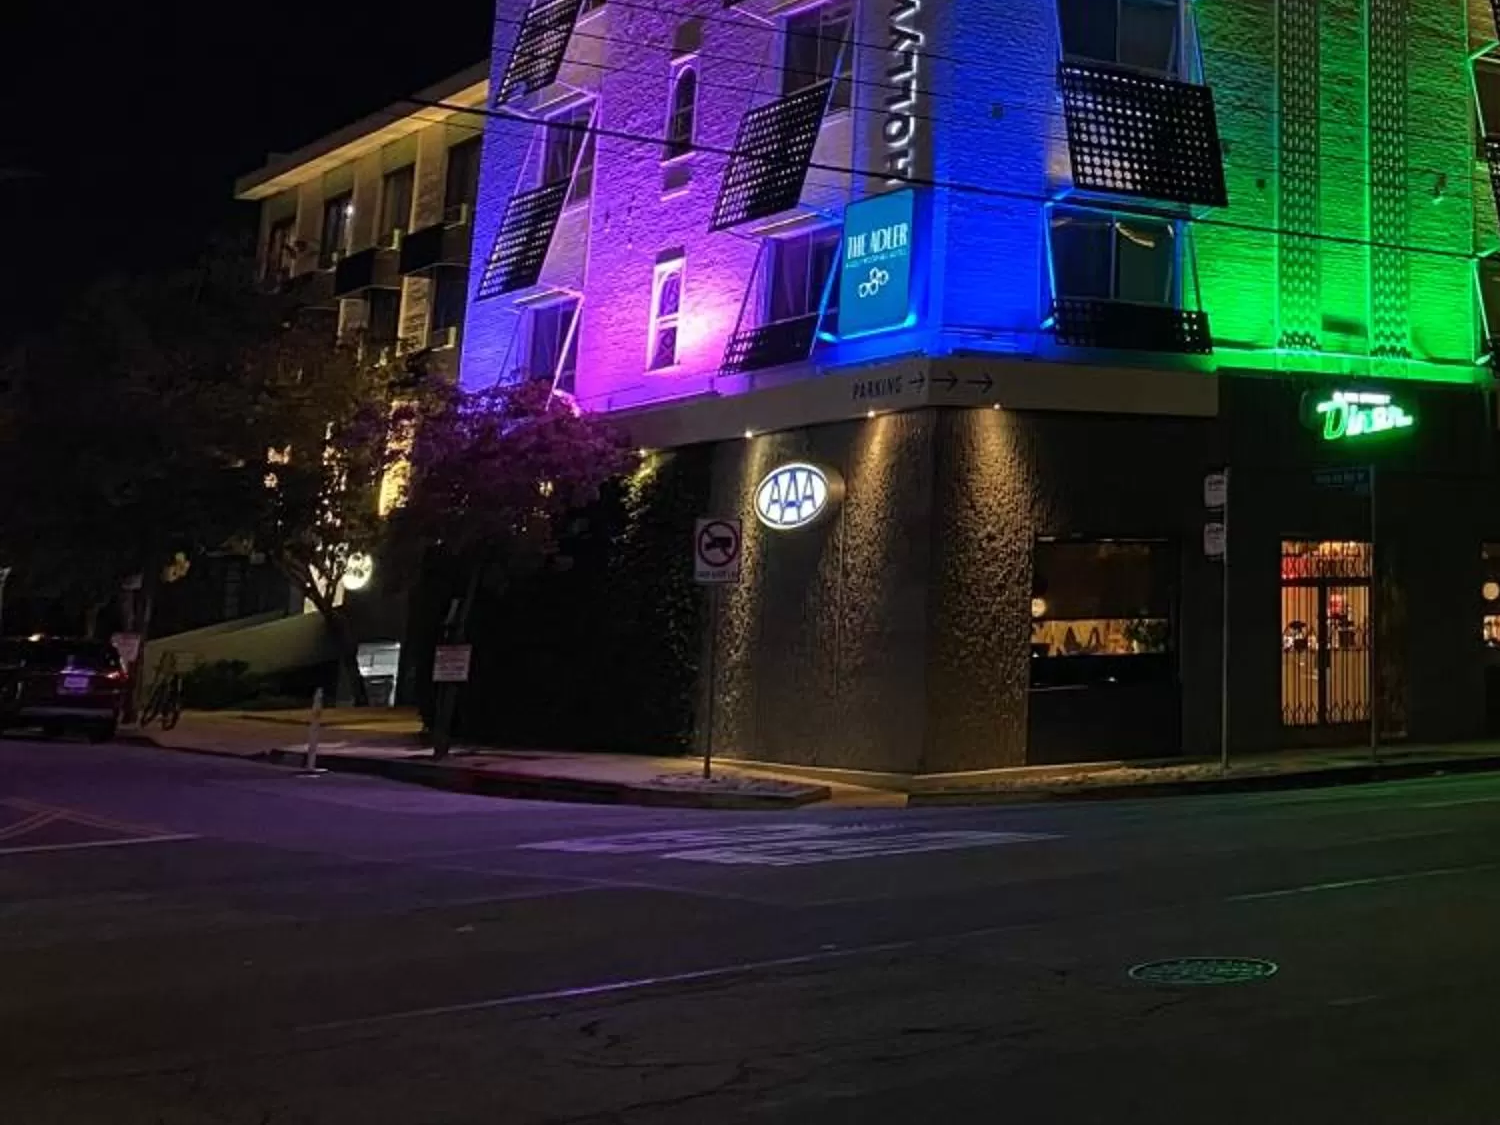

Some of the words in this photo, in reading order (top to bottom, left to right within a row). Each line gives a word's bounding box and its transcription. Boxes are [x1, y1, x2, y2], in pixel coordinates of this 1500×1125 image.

[847, 233, 868, 260] THE
[852, 376, 903, 400] PARKING
[1316, 401, 1413, 440] Diner
[765, 467, 818, 524] AAA
